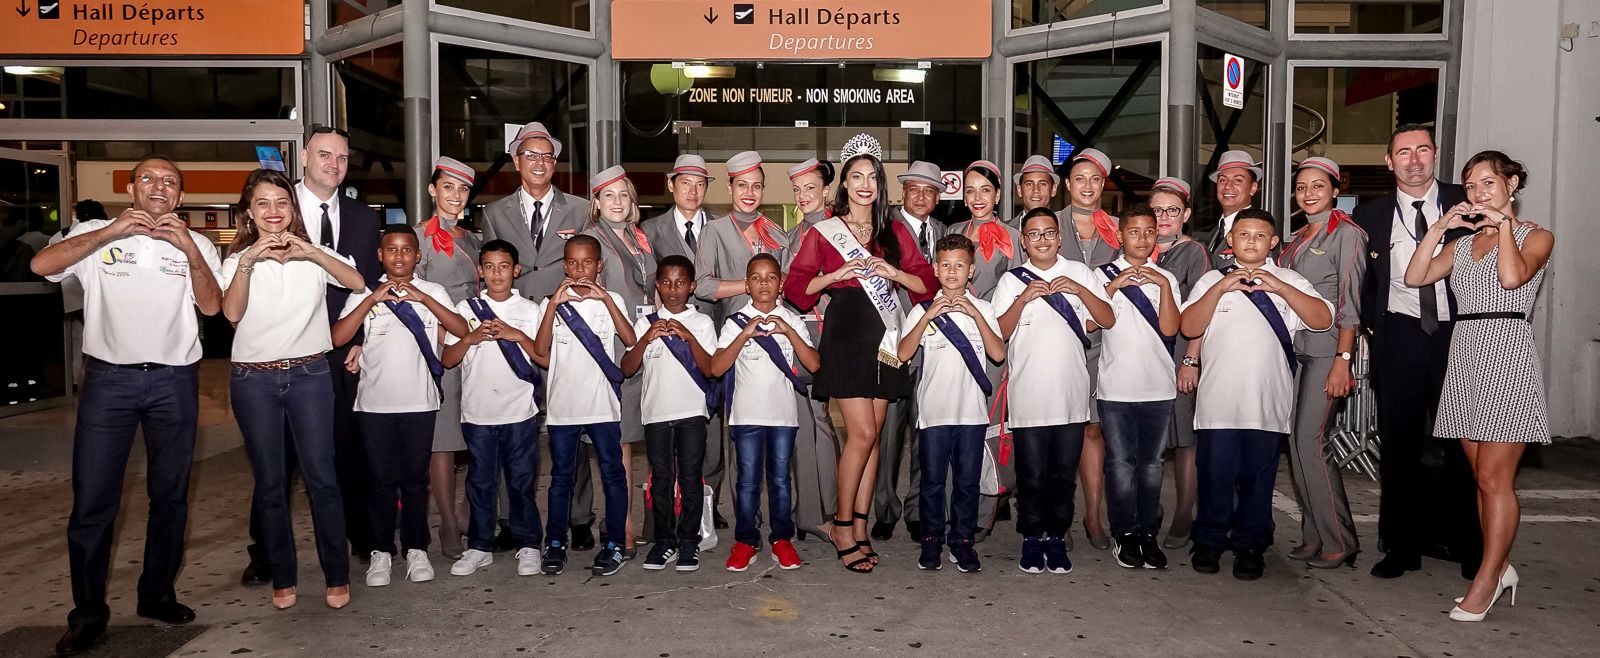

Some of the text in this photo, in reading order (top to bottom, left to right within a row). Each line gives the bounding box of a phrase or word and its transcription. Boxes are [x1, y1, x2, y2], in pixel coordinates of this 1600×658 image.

[73, 3, 205, 26] Hall Départs
[769, 6, 901, 30] Hall Départs
[73, 29, 179, 51] Departures
[769, 33, 874, 55] Departures
[688, 88, 718, 103] ZONE
[722, 88, 745, 103] NON
[750, 88, 793, 103] FUMEUR
[806, 88, 829, 104] NON
[833, 88, 881, 104] SMOKING
[886, 88, 915, 104] AREA
[879, 289, 898, 312] 2017
